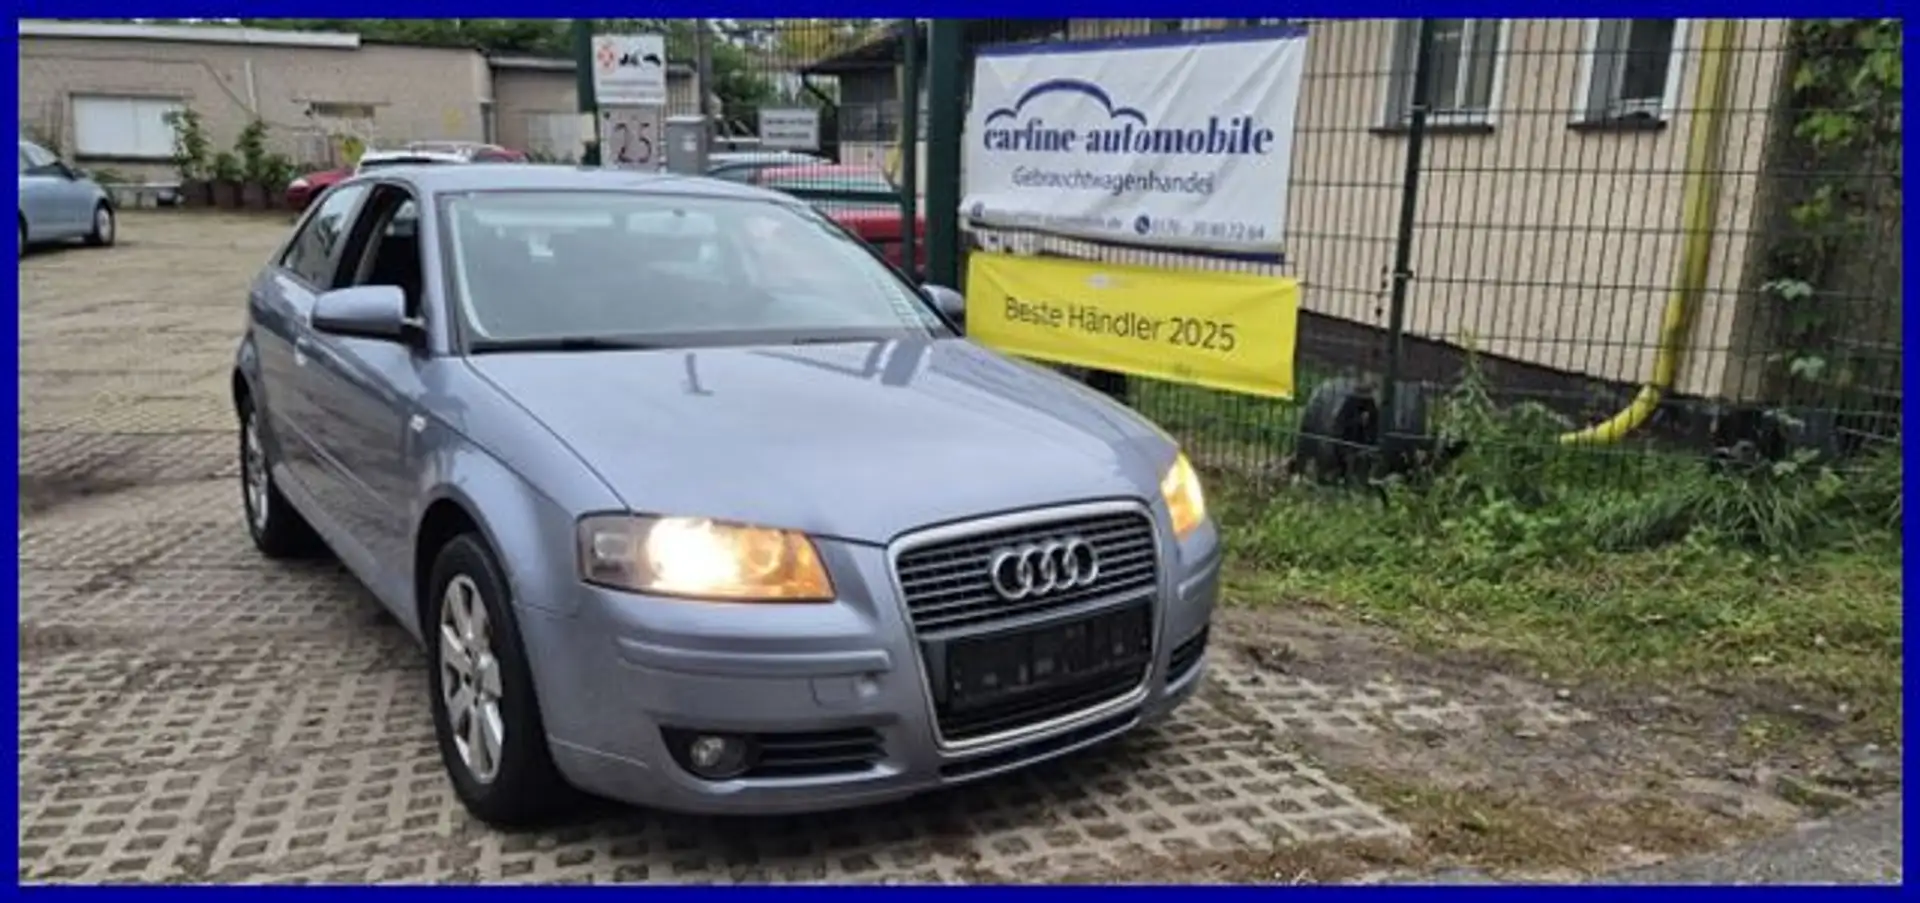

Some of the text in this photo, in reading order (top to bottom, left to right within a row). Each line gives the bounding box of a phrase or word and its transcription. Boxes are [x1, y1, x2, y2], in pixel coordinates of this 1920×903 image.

[614, 122, 652, 164] 25
[1005, 295, 1236, 352] Beste Händler 2025
